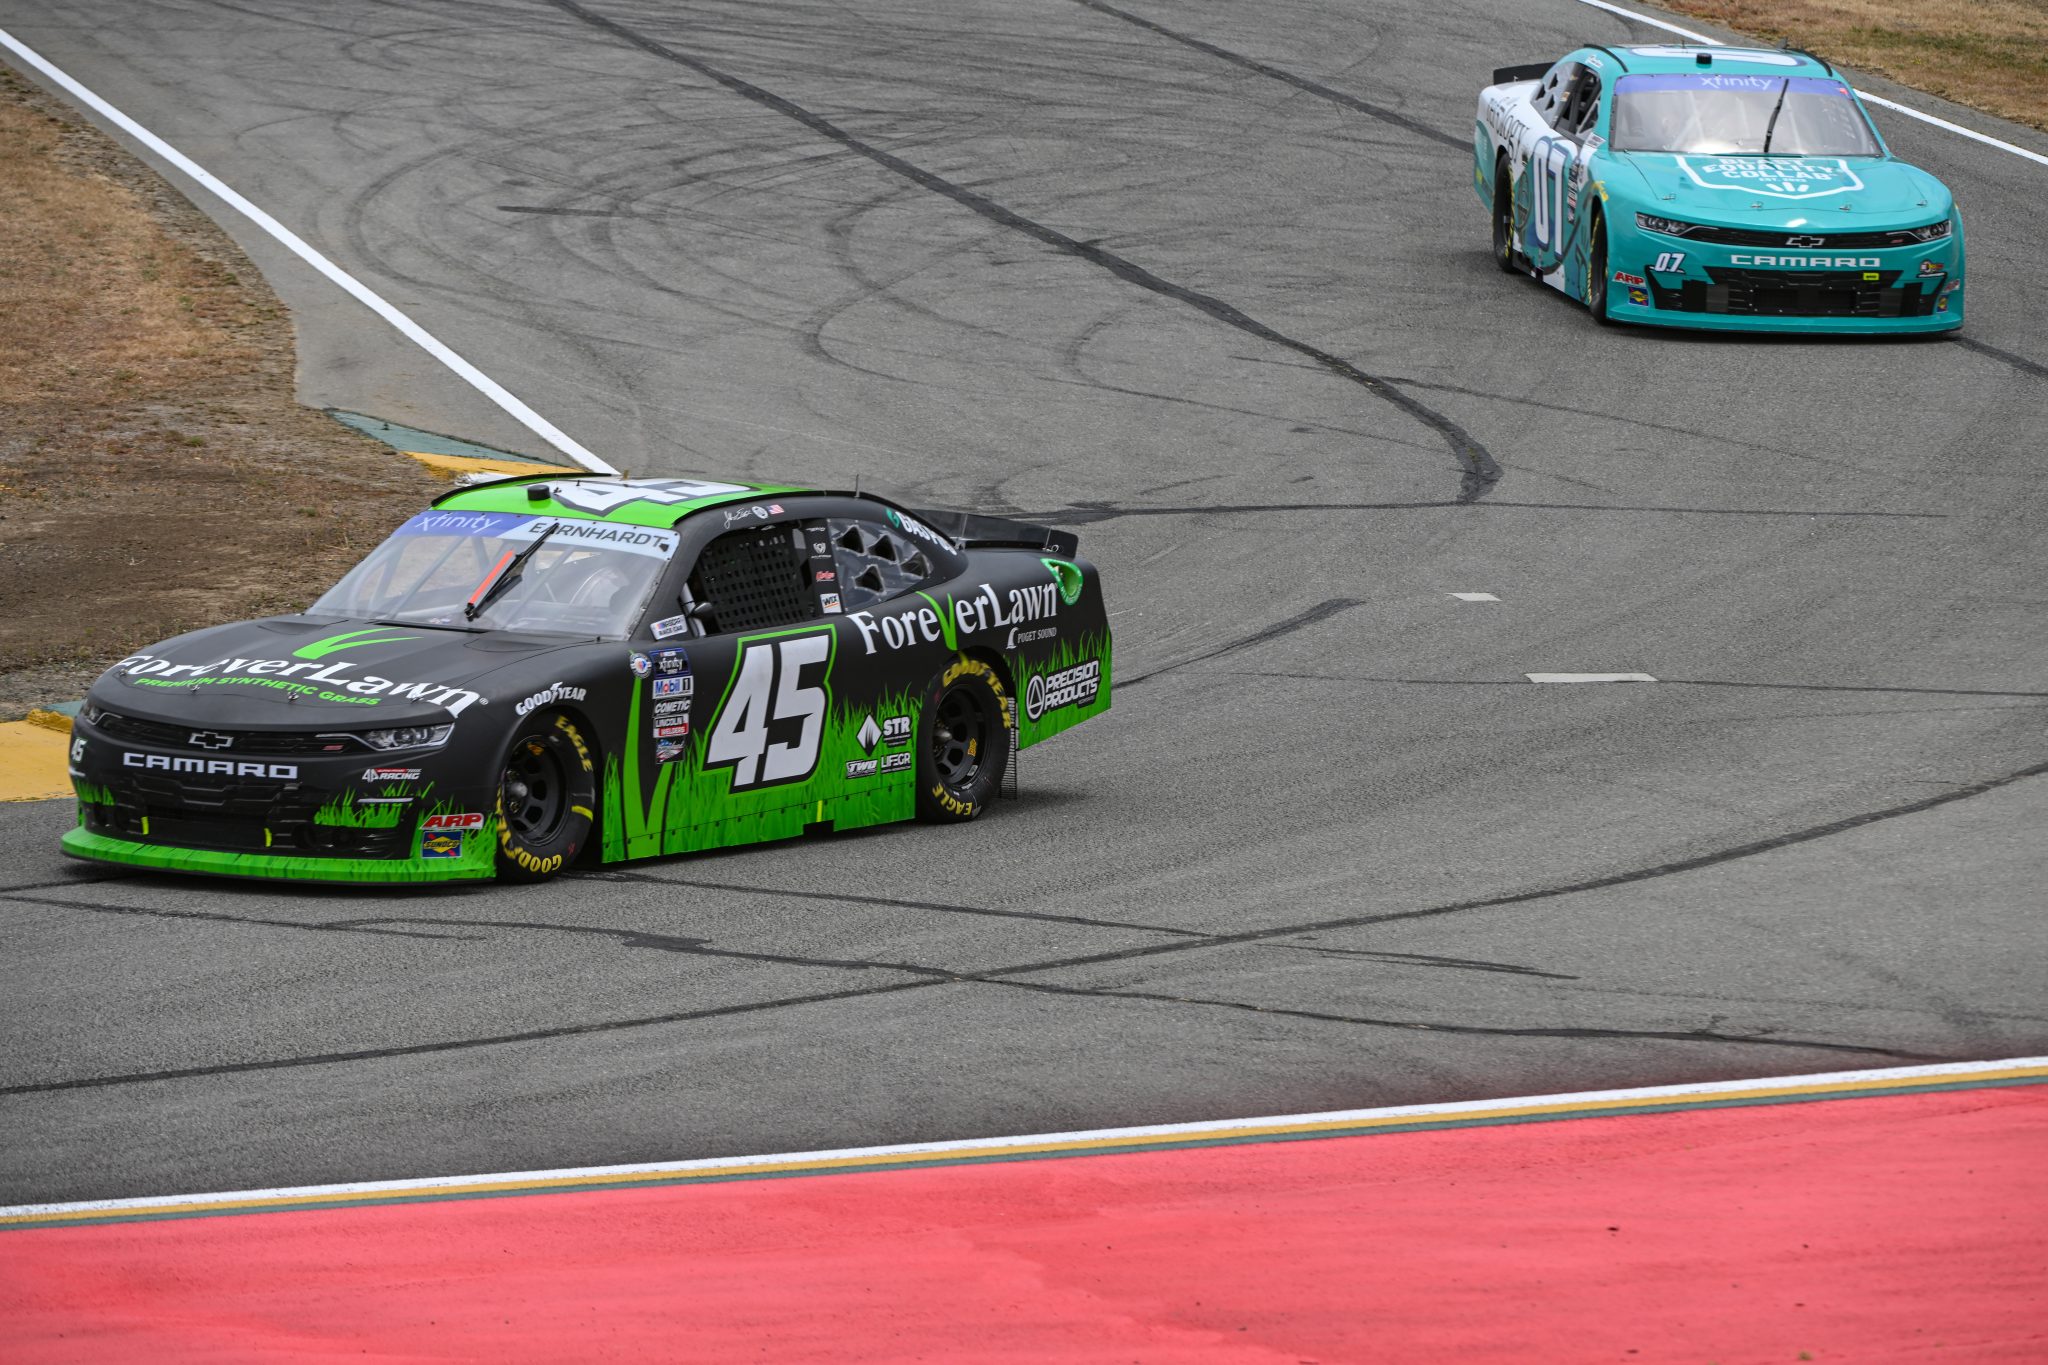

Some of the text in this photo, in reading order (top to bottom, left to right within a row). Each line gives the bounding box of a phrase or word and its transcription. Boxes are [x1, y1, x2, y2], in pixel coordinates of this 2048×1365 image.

[1701, 76, 1772, 90] xfinity
[1722, 170, 1832, 180] COLLAB
[1654, 253, 1685, 272] 07
[1731, 254, 1880, 267] CAMARO
[1614, 272, 1645, 285] ARP
[415, 512, 501, 533] xfinity
[529, 522, 669, 548] EARNHARDT
[655, 678, 690, 694] Mobil 1
[1045, 660, 1099, 693] PRECISION
[133, 677, 381, 706] PREMIUM SYNTHETIC GRASS
[515, 682, 587, 716] GOODYEAR
[1044, 676, 1099, 710] PRODUCTS
[654, 700, 691, 714] COMETIC
[707, 634, 829, 787] 45
[656, 716, 683, 727] LINCOLN
[883, 716, 910, 736] STR
[123, 752, 298, 779] CAMARO
[379, 772, 420, 780] RACING
[932, 782, 973, 816] EAGLE
[422, 815, 482, 828] ARP
[424, 841, 461, 849] SUNOCO
